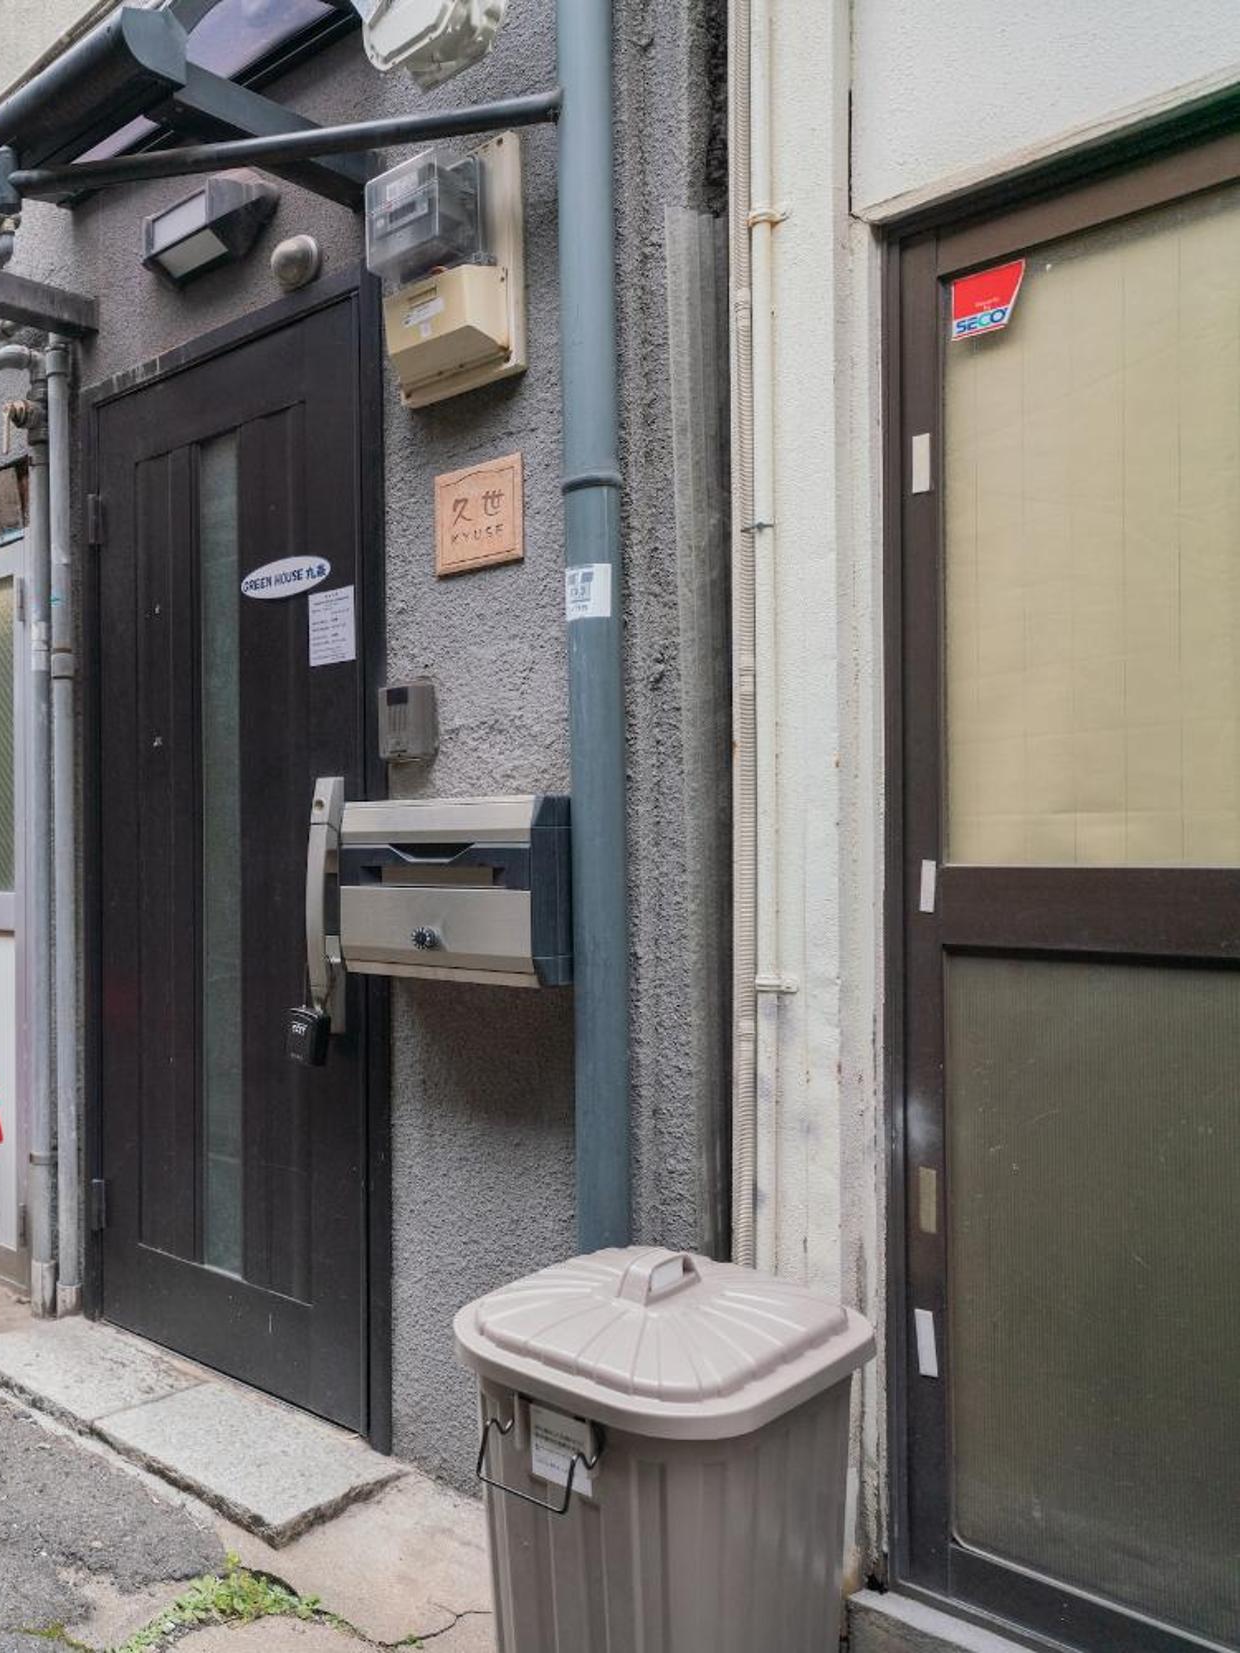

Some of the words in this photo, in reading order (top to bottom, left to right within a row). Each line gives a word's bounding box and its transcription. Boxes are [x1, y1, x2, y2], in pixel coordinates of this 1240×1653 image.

[452, 488, 505, 527] 久世
[243, 576, 272, 593] GREEN
[274, 568, 303, 587] HOUSE
